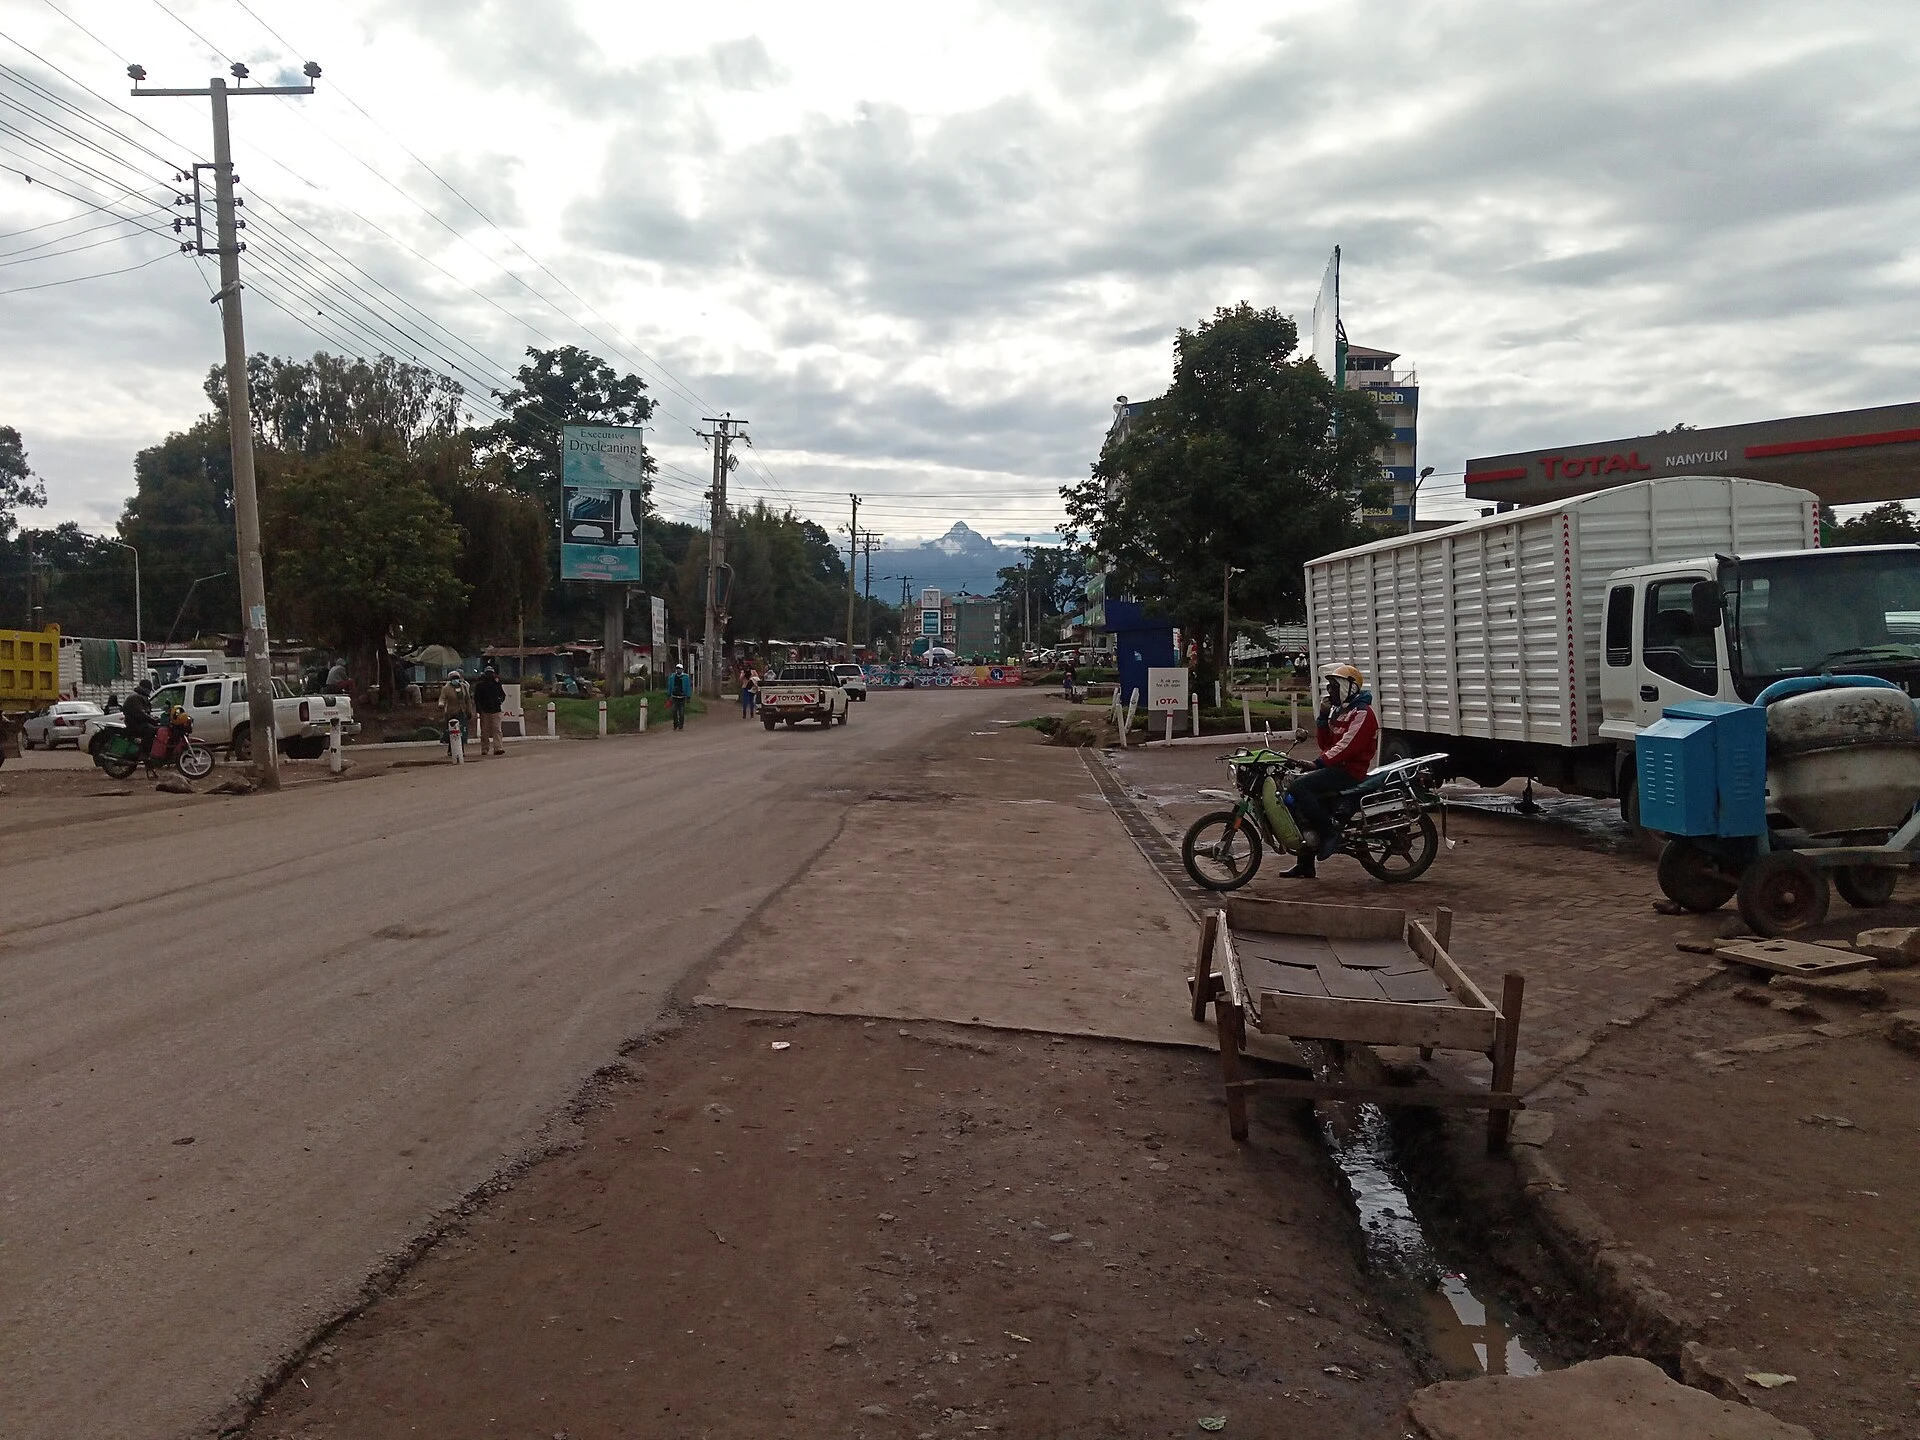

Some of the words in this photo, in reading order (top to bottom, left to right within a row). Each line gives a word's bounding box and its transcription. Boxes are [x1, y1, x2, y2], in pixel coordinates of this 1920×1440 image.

[1379, 392, 1404, 402] betin
[580, 429, 625, 439] Executive
[569, 440, 637, 455] Drycleaning
[1538, 452, 1651, 480] TOTAL
[1665, 449, 1728, 467] NANYUKI
